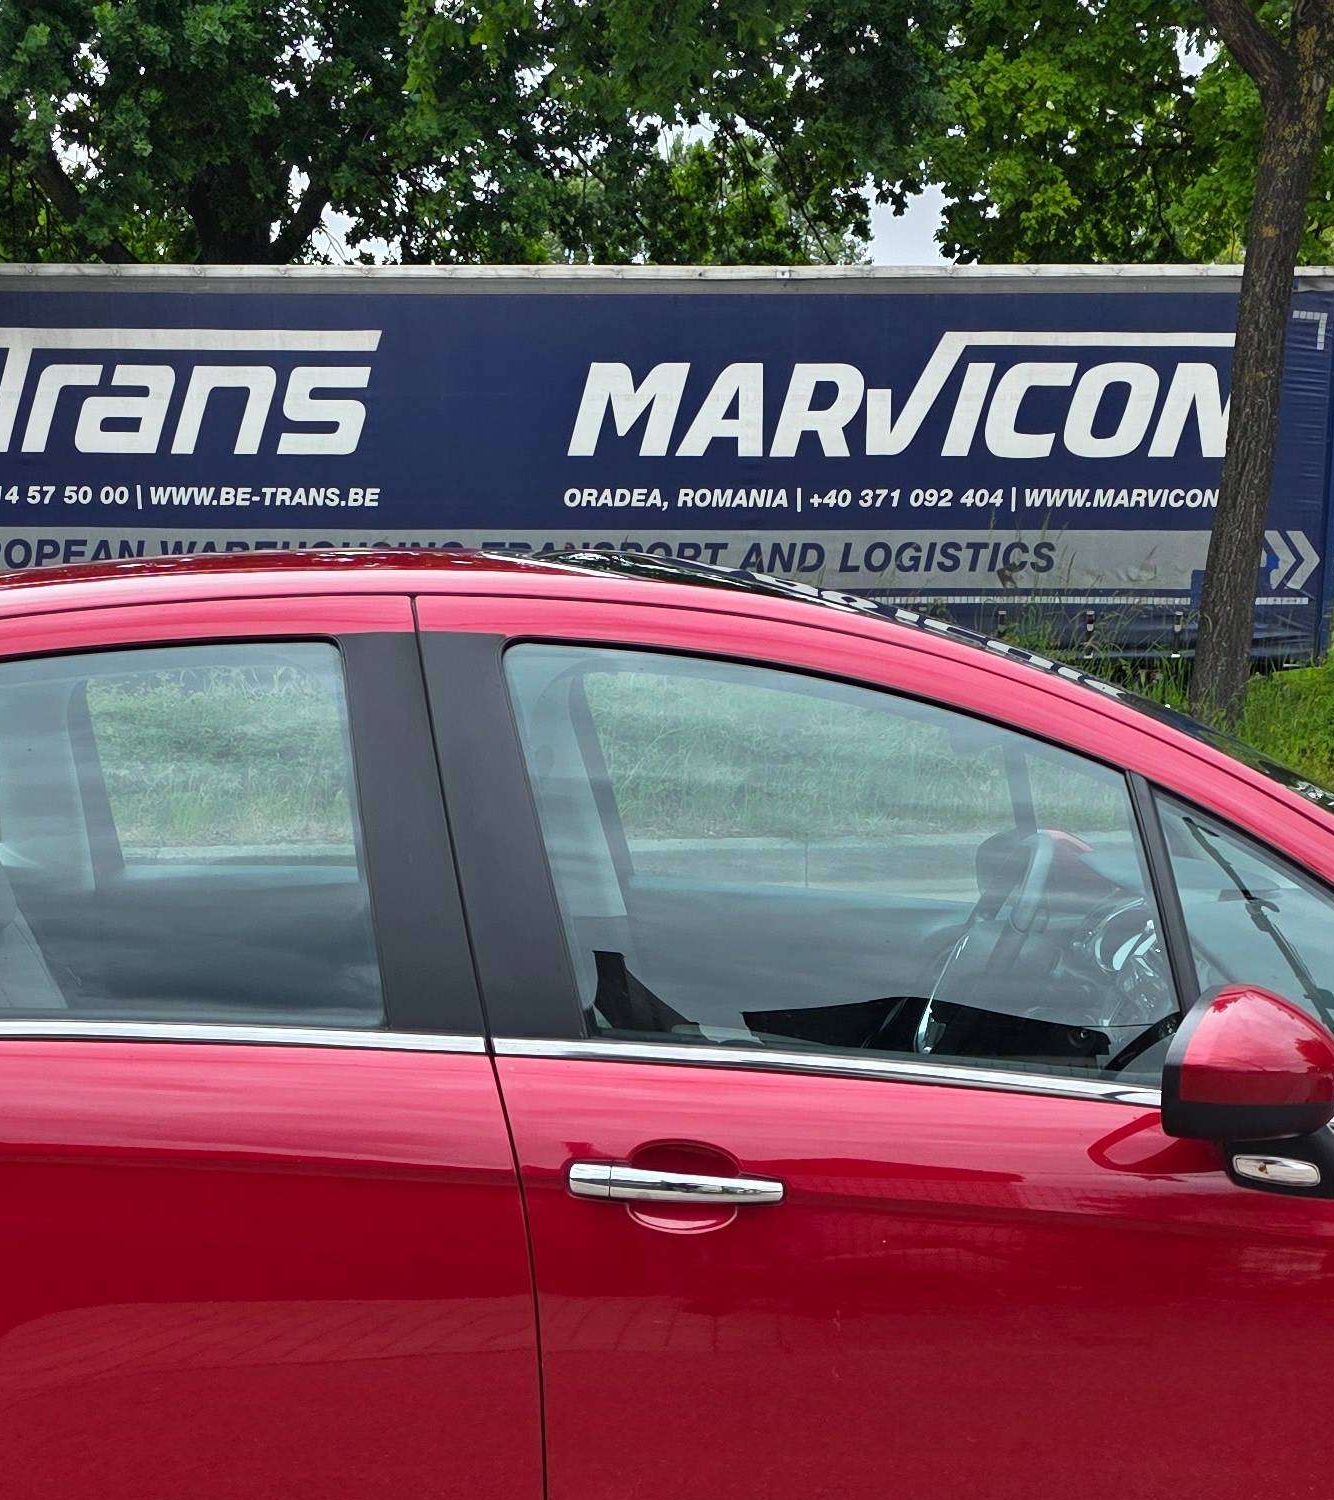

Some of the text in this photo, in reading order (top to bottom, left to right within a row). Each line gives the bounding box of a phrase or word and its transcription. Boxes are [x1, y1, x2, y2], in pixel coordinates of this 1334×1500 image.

[567, 331, 1236, 459] MARVICON
[26, 485, 56, 504] 57
[63, 485, 93, 505] 50
[99, 485, 130, 505] 00
[149, 486, 381, 507] WWW.BE-TRANS.BE
[563, 487, 669, 512] ORADEA,
[677, 488, 789, 508] ROMANIA
[809, 488, 852, 508] +40
[858, 488, 901, 508] 371
[909, 488, 954, 508] 092
[959, 488, 1004, 508] 404
[737, 542, 826, 573] AND
[838, 541, 1056, 573] LOGISTICS
